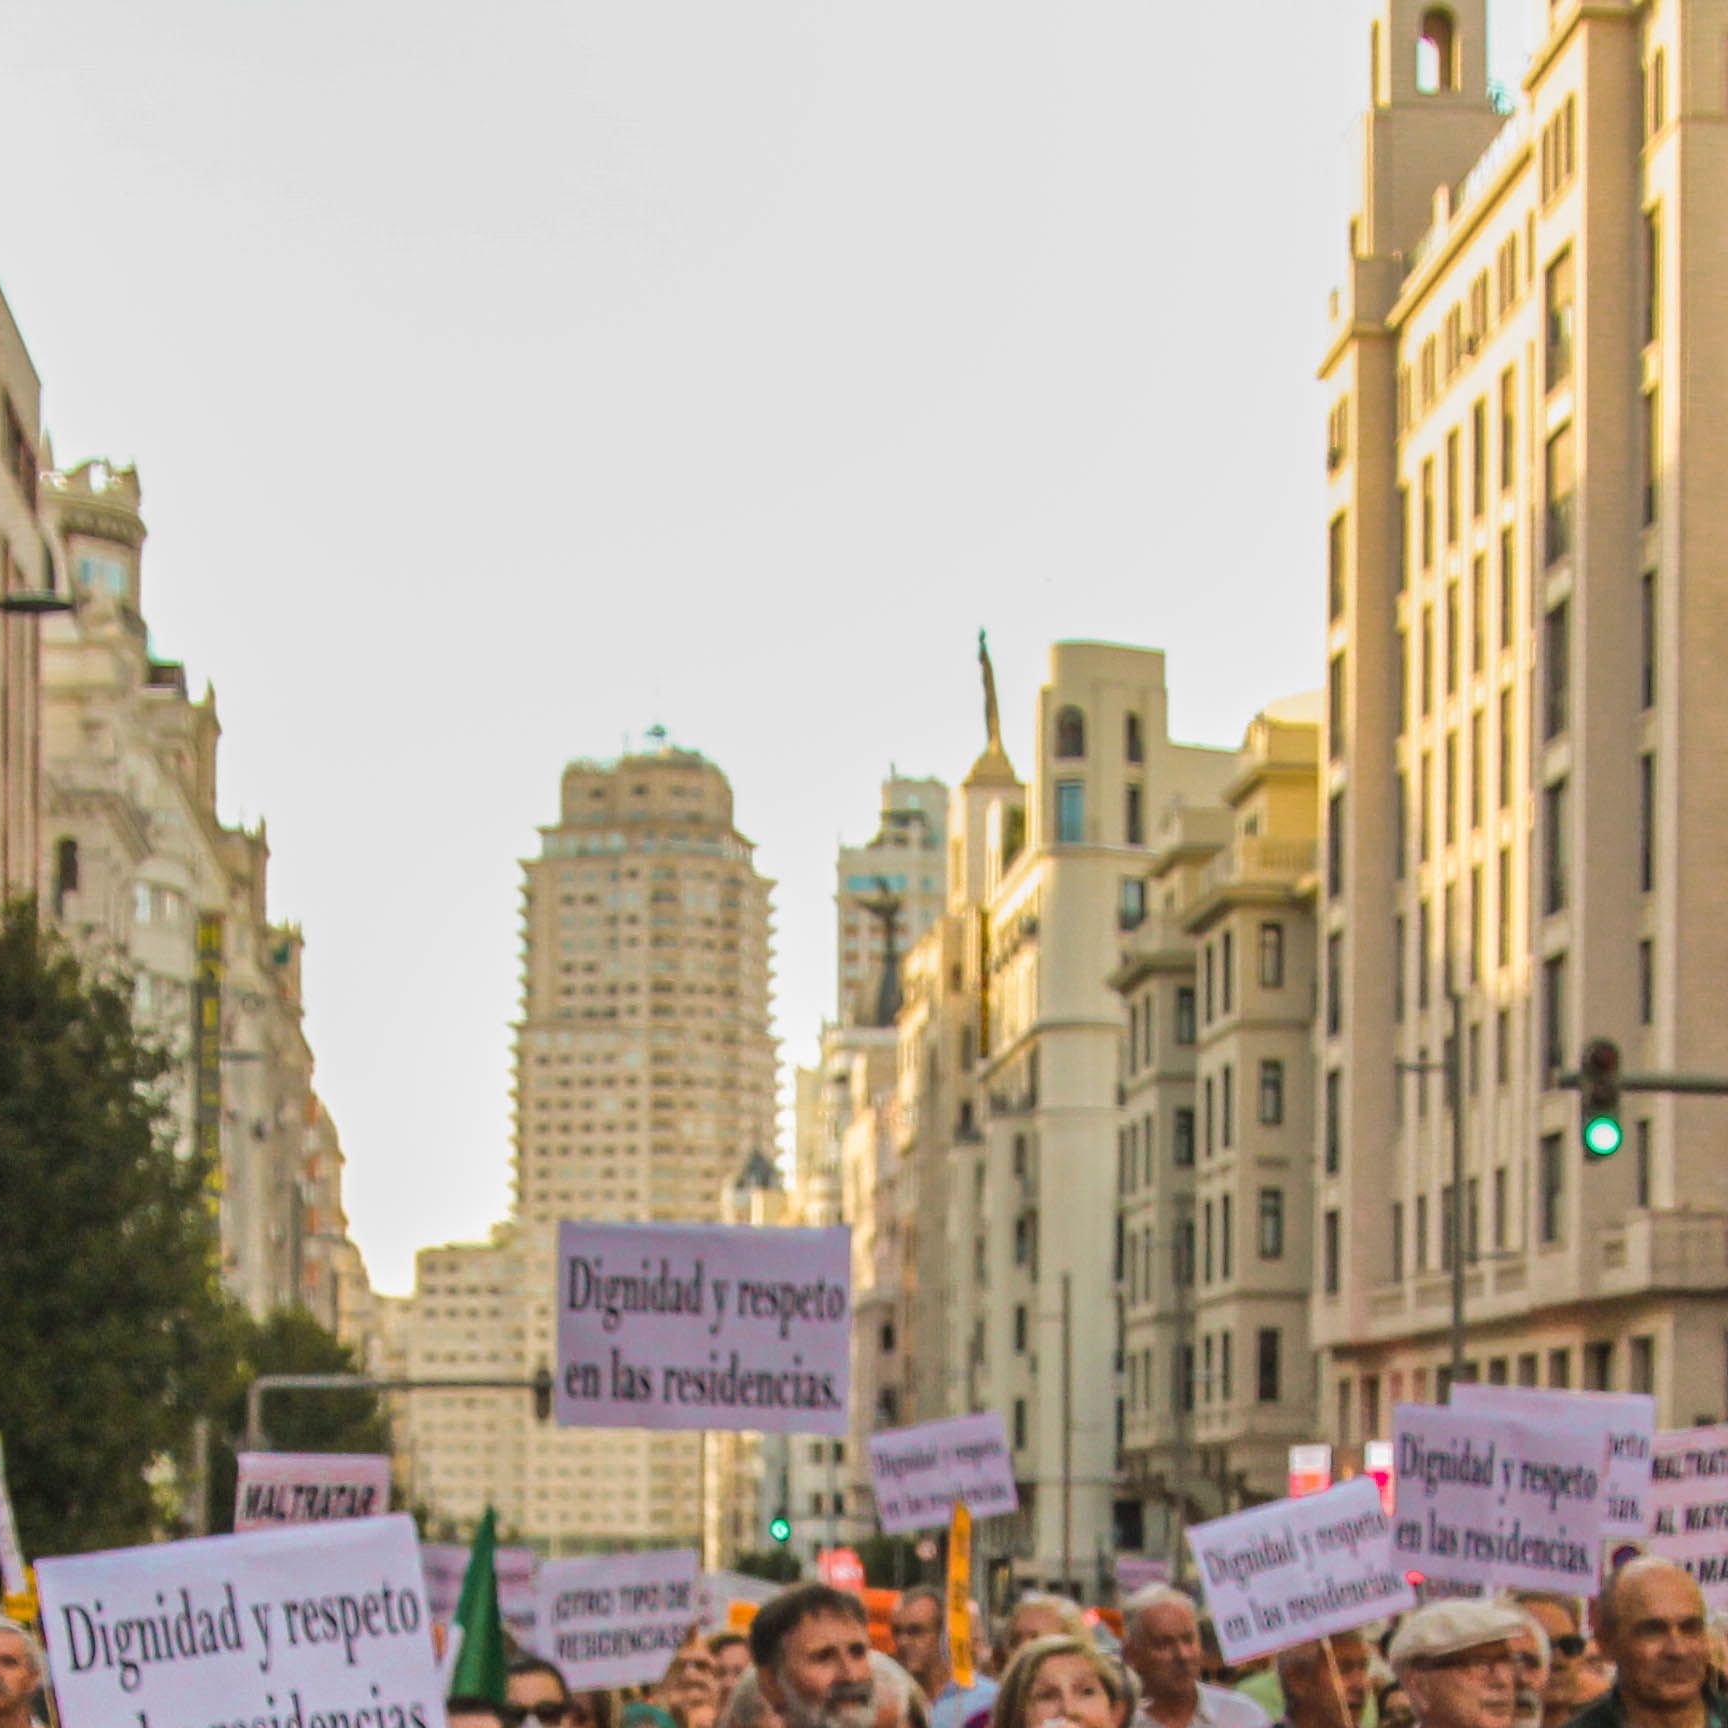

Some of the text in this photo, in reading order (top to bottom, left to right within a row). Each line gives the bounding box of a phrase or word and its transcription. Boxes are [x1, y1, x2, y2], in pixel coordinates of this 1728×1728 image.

[568, 1255, 847, 1340] Dignidad y respeto
[566, 1349, 843, 1411] en las residencias.
[246, 1483, 376, 1520] MALTRATAR
[1400, 1432, 1495, 1496] Dignidad
[1503, 1458, 1515, 1502] y
[1521, 1456, 1598, 1510] respeto
[1202, 1538, 1299, 1592] Dignidad
[1300, 1535, 1314, 1568] y
[1314, 1509, 1389, 1558] respeto
[1397, 1509, 1590, 1576] en las residencias.
[61, 1577, 242, 1690] Dignidad
[252, 1603, 275, 1672] y
[285, 1579, 421, 1668] respeto
[1223, 1618, 1250, 1644] en
[1252, 1600, 1286, 1634] las
